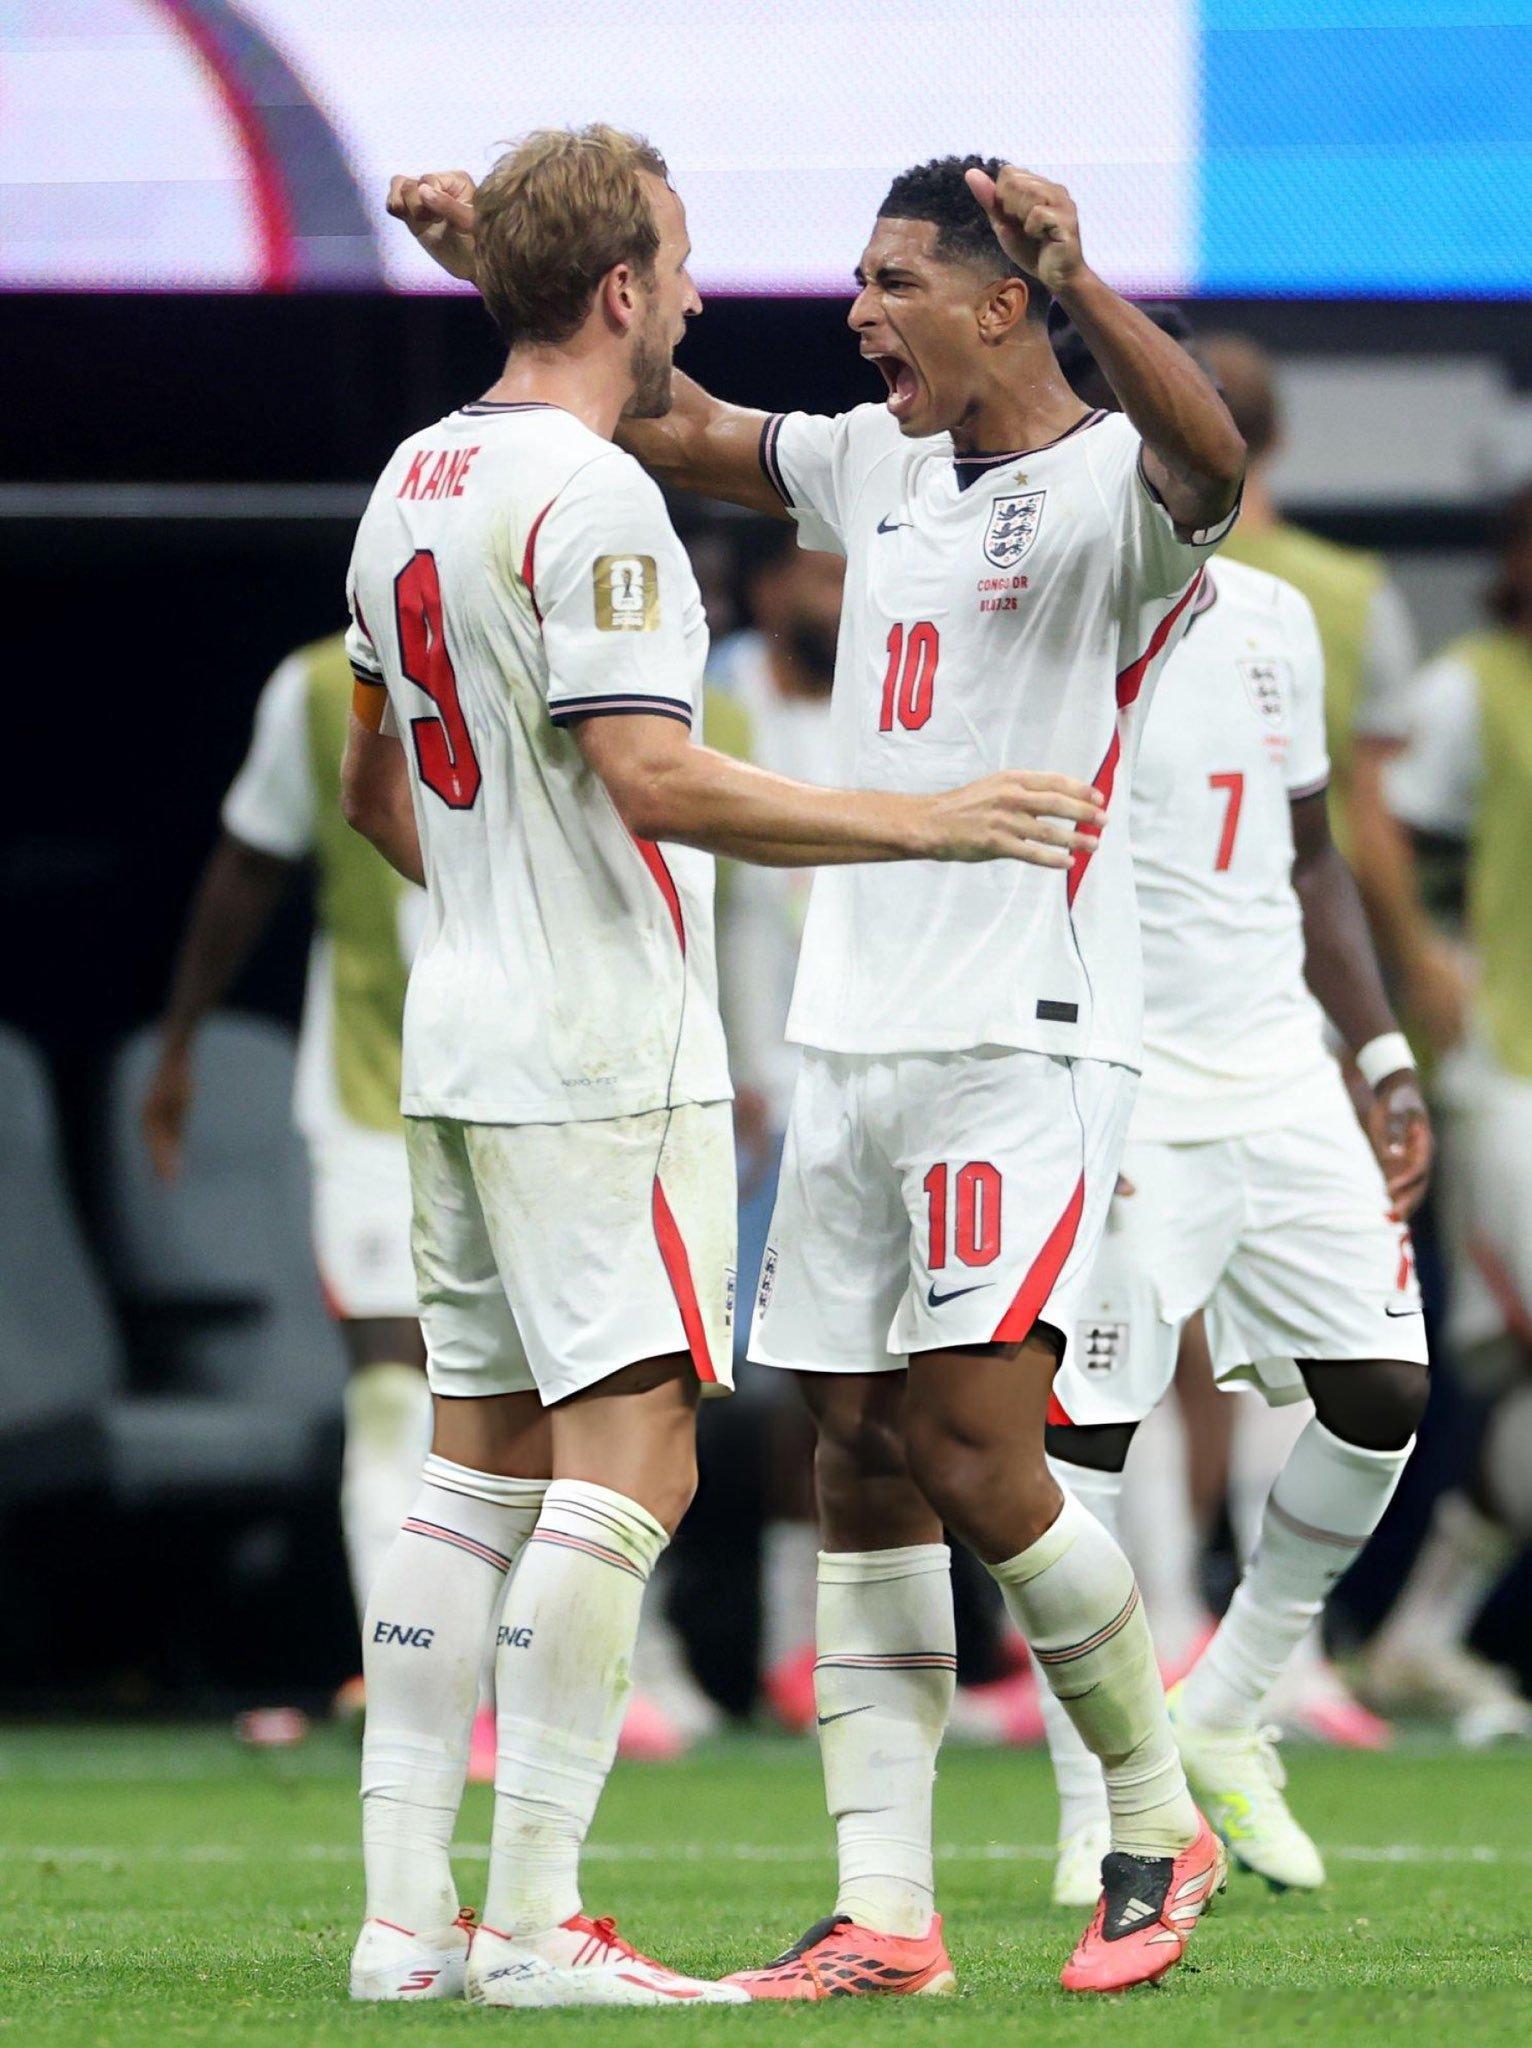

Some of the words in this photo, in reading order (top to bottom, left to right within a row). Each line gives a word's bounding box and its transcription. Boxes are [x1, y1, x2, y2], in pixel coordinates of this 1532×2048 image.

[397, 446, 481, 500] KANE
[1013, 576, 1028, 589] DR
[394, 548, 482, 810] 9
[879, 621, 939, 731] 10
[1208, 773, 1243, 871] 7
[923, 1161, 1002, 1270] 10
[372, 1621, 434, 1649] ENG
